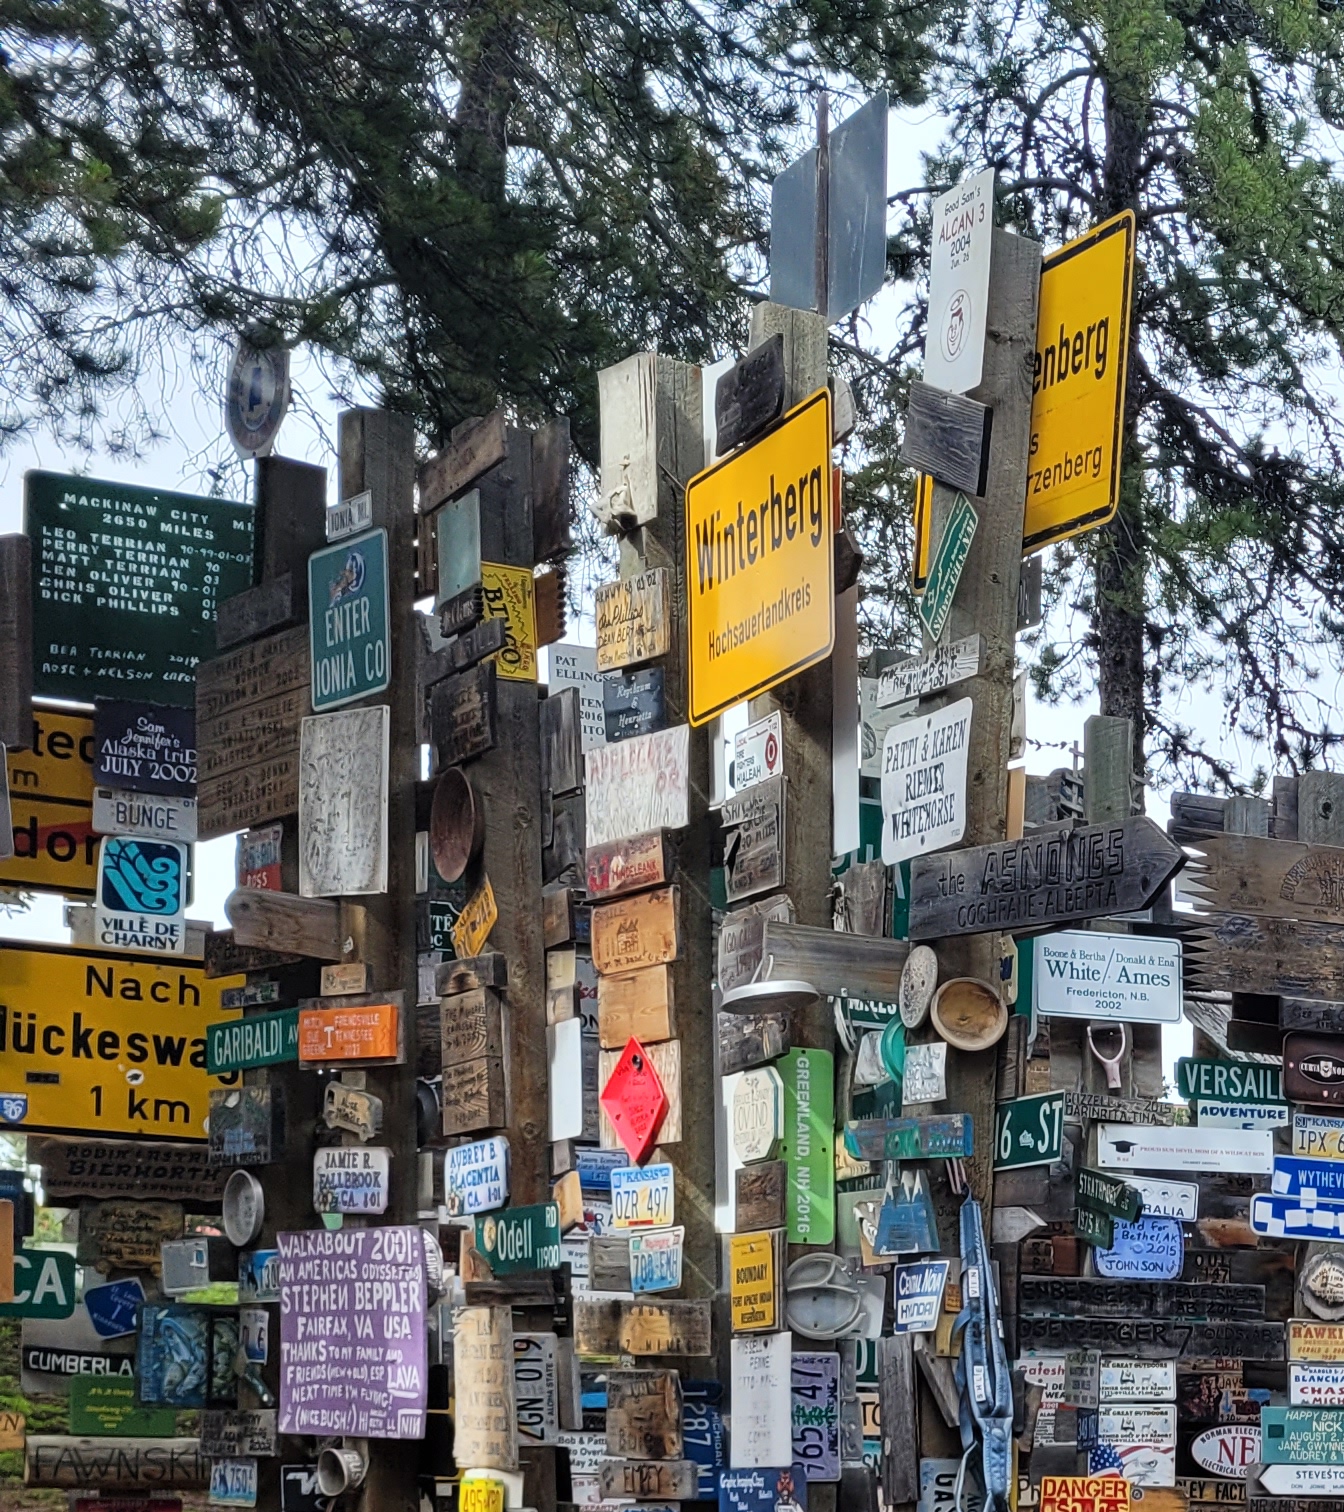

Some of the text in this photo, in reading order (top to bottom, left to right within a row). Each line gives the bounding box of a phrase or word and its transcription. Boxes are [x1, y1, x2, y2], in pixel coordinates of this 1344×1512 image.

[939, 212, 975, 243] ALCAN
[950, 233, 971, 257] 2004
[65, 493, 209, 524] MACKINAW CITY
[696, 464, 822, 594] Winterberg
[43, 539, 100, 554] PERRY
[325, 596, 371, 648] ENTER
[709, 577, 812, 660] Hochsauerlandkreis
[316, 657, 357, 700] IONIA
[885, 717, 968, 774] PATTI KAREN
[101, 756, 141, 774] JULY
[115, 804, 178, 830] BUNGE
[101, 932, 179, 950] CHARNY
[155, 924, 179, 936] DE
[86, 967, 200, 1006] Nach
[1047, 959, 1171, 987] White Ames
[1095, 1000, 1121, 1009] 2002
[214, 1018, 283, 1067] GARIBALDI
[129, 1090, 190, 1122] km
[1200, 1105, 1286, 1120] ADVENTURE
[794, 1057, 811, 1233] GREENLAND, NH 2016
[1299, 1130, 1326, 1152] IPX
[647, 1186, 669, 1215] 497
[279, 1232, 365, 1258] WALKABOUT
[497, 1207, 556, 1261] Odell RD
[736, 1263, 767, 1284] BOUNDARY
[1313, 1421, 1343, 1431] NICK
[1042, 1480, 1127, 1498] DANGER
